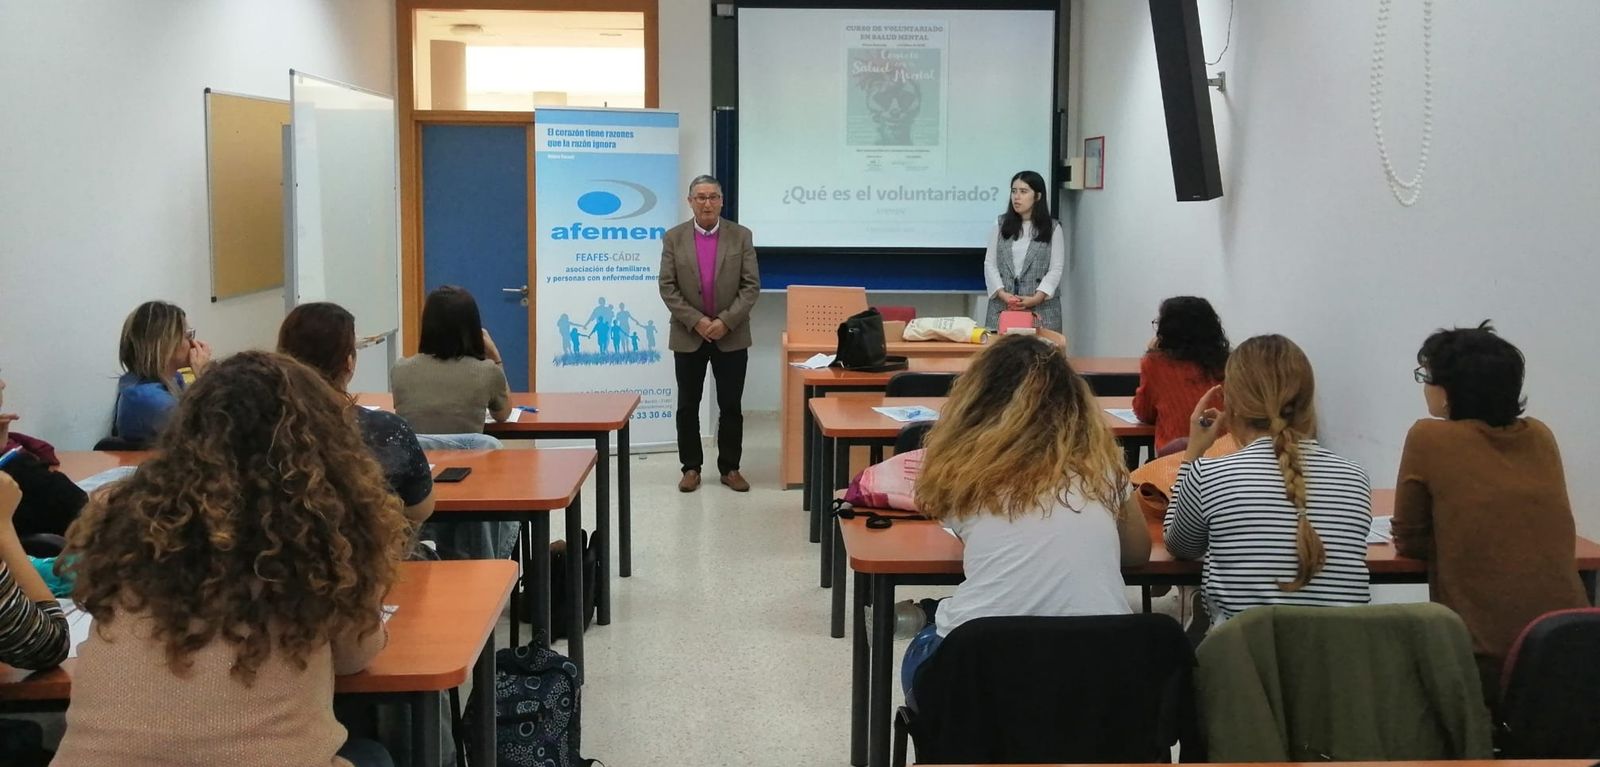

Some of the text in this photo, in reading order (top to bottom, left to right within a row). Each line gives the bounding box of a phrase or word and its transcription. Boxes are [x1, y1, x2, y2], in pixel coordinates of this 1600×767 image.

[852, 60, 893, 74] Salud
[547, 128, 635, 139] El corazón tiene razones
[547, 140, 617, 149] que la razón ignora
[782, 185, 999, 204] ¿Qué es el voluntariado?
[551, 222, 666, 240] afemen
[576, 251, 640, 261] FEAFES-CÁDIZ
[565, 265, 651, 273] asociación de familiares
[546, 275, 551, 283] y
[553, 275, 586, 283] personas
[602, 273, 643, 281] enfermedad
[636, 411, 647, 419] 33
[649, 411, 659, 419] 30
